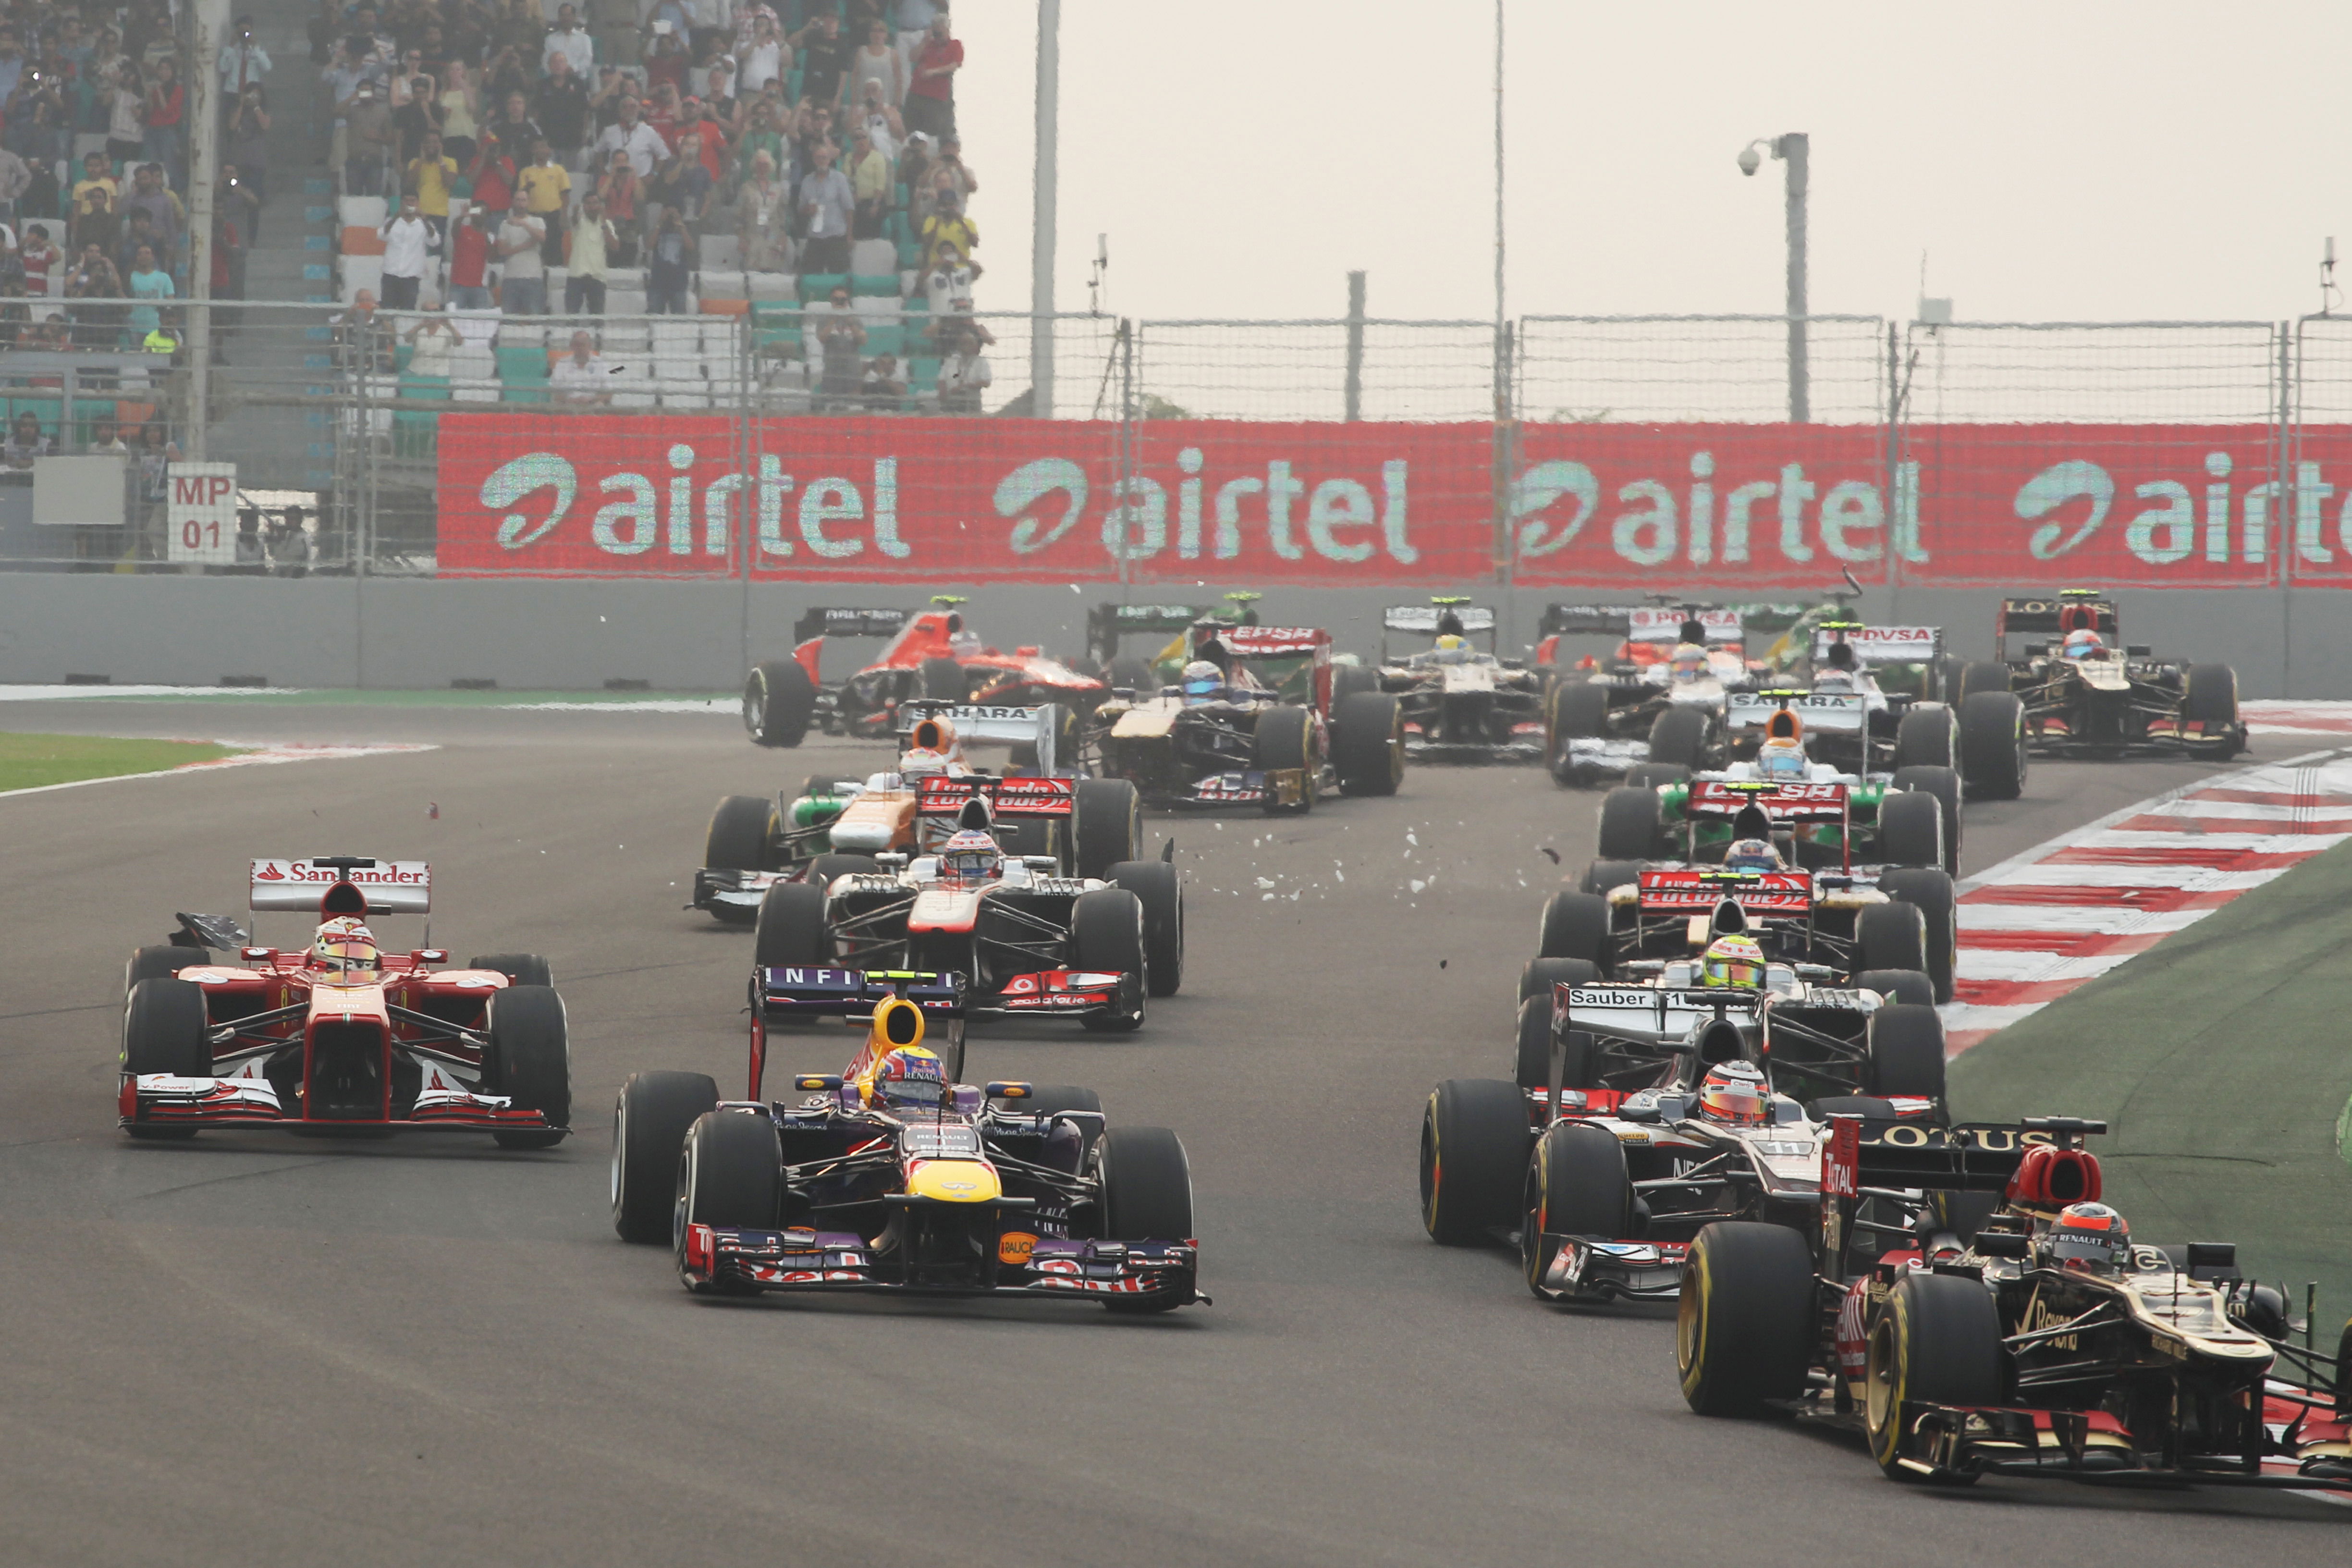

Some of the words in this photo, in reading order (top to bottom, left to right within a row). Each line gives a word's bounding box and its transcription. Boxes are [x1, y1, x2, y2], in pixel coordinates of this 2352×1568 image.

[176, 477, 230, 506] MP
[592, 443, 910, 558] airtel
[1101, 447, 1419, 564] airtel
[1612, 451, 1929, 565] airtel
[2126, 452, 2352, 564] airt
[183, 520, 220, 549] 01
[2006, 601, 2111, 614] LOS
[1734, 695, 1847, 707] SARA
[926, 780, 1048, 806] Lucade
[1704, 782, 1836, 798] CSA
[290, 863, 424, 883] Sanander
[765, 968, 952, 988] INFII
[1571, 990, 1646, 1005] Sauber
[904, 1072, 942, 1082] RENAULT
[1767, 1142, 1800, 1154] 11
[2059, 1234, 2103, 1246] RENAULT
